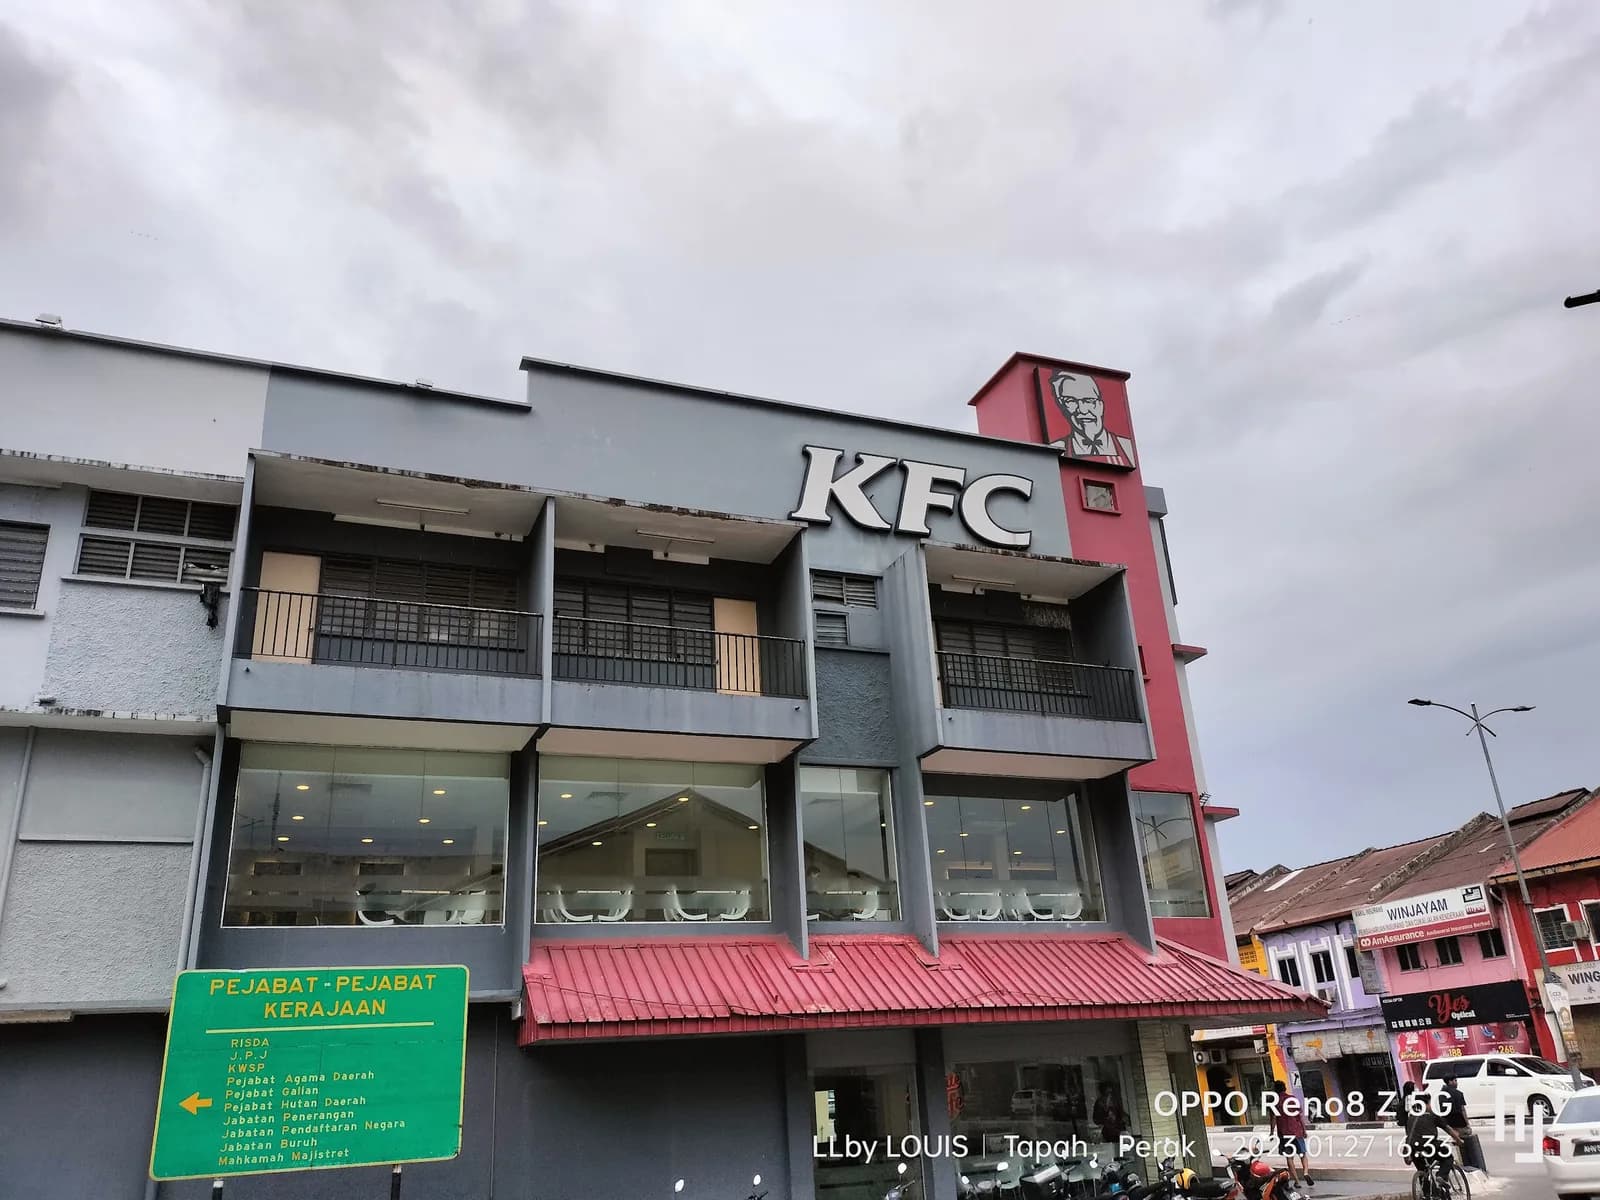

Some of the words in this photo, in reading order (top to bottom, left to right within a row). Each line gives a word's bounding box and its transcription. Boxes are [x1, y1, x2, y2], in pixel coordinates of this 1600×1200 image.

[787, 444, 1034, 549] KFC
[1387, 898, 1449, 921] WINJAYAM
[1371, 930, 1425, 946] AmAssurance
[264, 999, 386, 1019] KERAJAAN
[1428, 993, 1470, 1023] Yes
[1451, 1010, 1476, 1020] Optical
[231, 1038, 269, 1048] RISDA
[229, 1051, 268, 1061] J.P.J
[228, 1063, 265, 1073] KWSP
[226, 1076, 276, 1088] Pejabat
[284, 1073, 326, 1085] Agama
[333, 1071, 375, 1081] Daerah
[225, 1088, 274, 1100] Pejabat
[282, 1086, 319, 1096] Galian
[224, 1102, 273, 1115] Pejabat
[281, 1099, 317, 1109] Hutan
[324, 1096, 366, 1107] Daerah
[223, 1115, 275, 1126] Jabatan
[283, 1111, 354, 1123] Penerangan
[222, 1128, 274, 1139] Jabatan
[281, 1123, 357, 1135] Pendaftaran
[364, 1120, 406, 1131] Negara
[220, 1142, 272, 1153] Jabatan
[280, 1138, 317, 1149] Buruh
[218, 1154, 284, 1166] Mahkamah
[291, 1148, 350, 1161] Majistret
